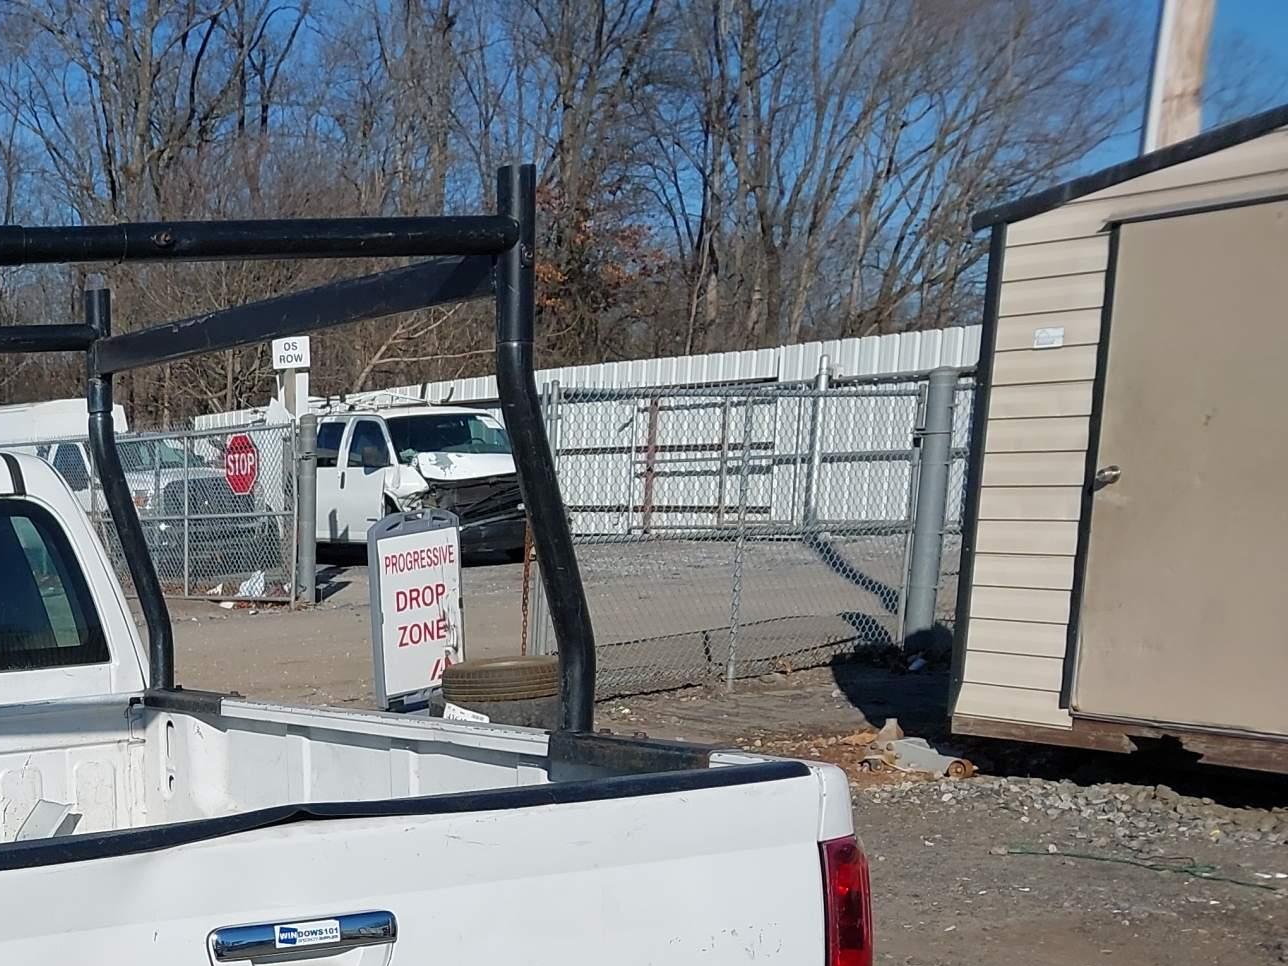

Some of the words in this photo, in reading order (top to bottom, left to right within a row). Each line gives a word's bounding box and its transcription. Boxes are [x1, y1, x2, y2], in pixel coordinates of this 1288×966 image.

[279, 353, 303, 364] ROW
[283, 341, 298, 352] OS
[227, 453, 255, 476] STOP
[384, 544, 455, 575] PROGRESSIVE
[396, 583, 446, 613] DROP
[398, 619, 447, 648] ZONE
